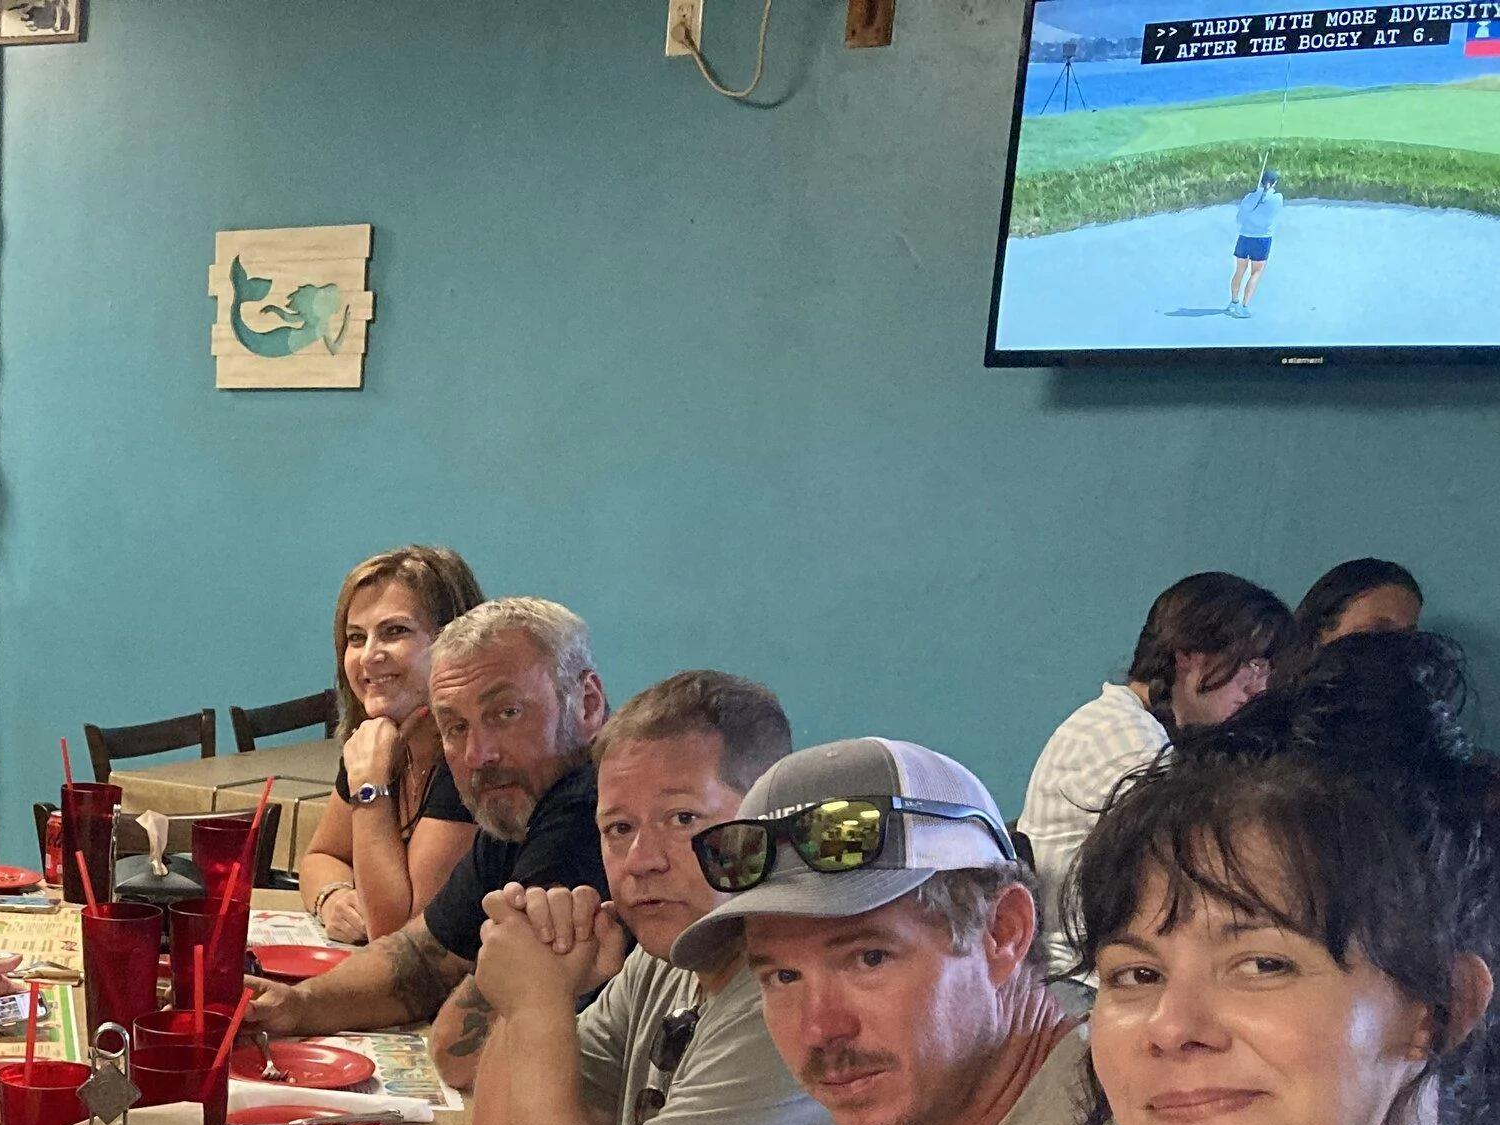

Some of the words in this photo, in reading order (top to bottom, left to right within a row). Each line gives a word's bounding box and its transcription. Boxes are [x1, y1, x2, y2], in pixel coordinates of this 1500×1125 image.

[1192, 17, 1251, 37] TARDY
[1264, 13, 1314, 31] WITH
[1326, 8, 1377, 26] MORE
[1154, 45, 1165, 61] 7
[1176, 40, 1237, 59] AFTER
[1249, 35, 1286, 54] THE
[1298, 30, 1361, 50] BOGEY
[1373, 28, 1401, 45] AT
[1412, 27, 1435, 43] 6.
